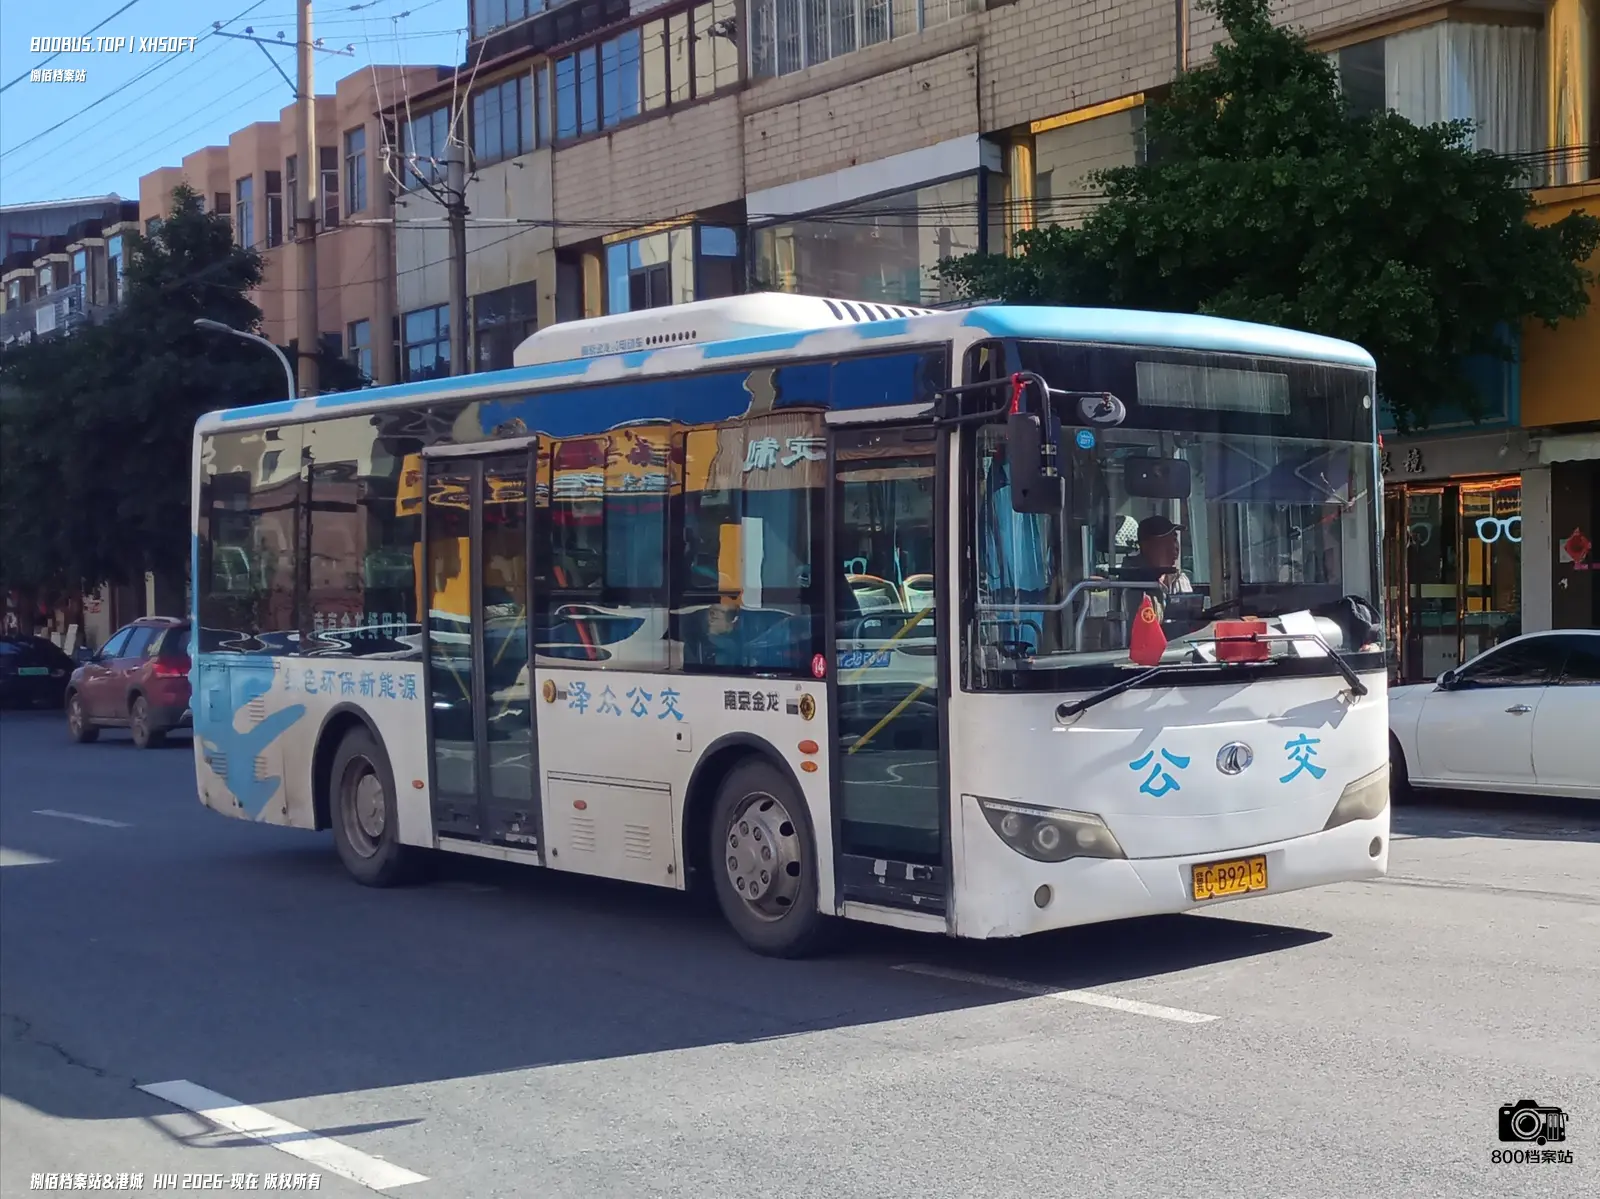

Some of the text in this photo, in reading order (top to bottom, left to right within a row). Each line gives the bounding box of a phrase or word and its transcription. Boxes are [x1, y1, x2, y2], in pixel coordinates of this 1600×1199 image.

[567, 681, 685, 721] 泽众公交
[723, 690, 779, 712] 南京金龙
